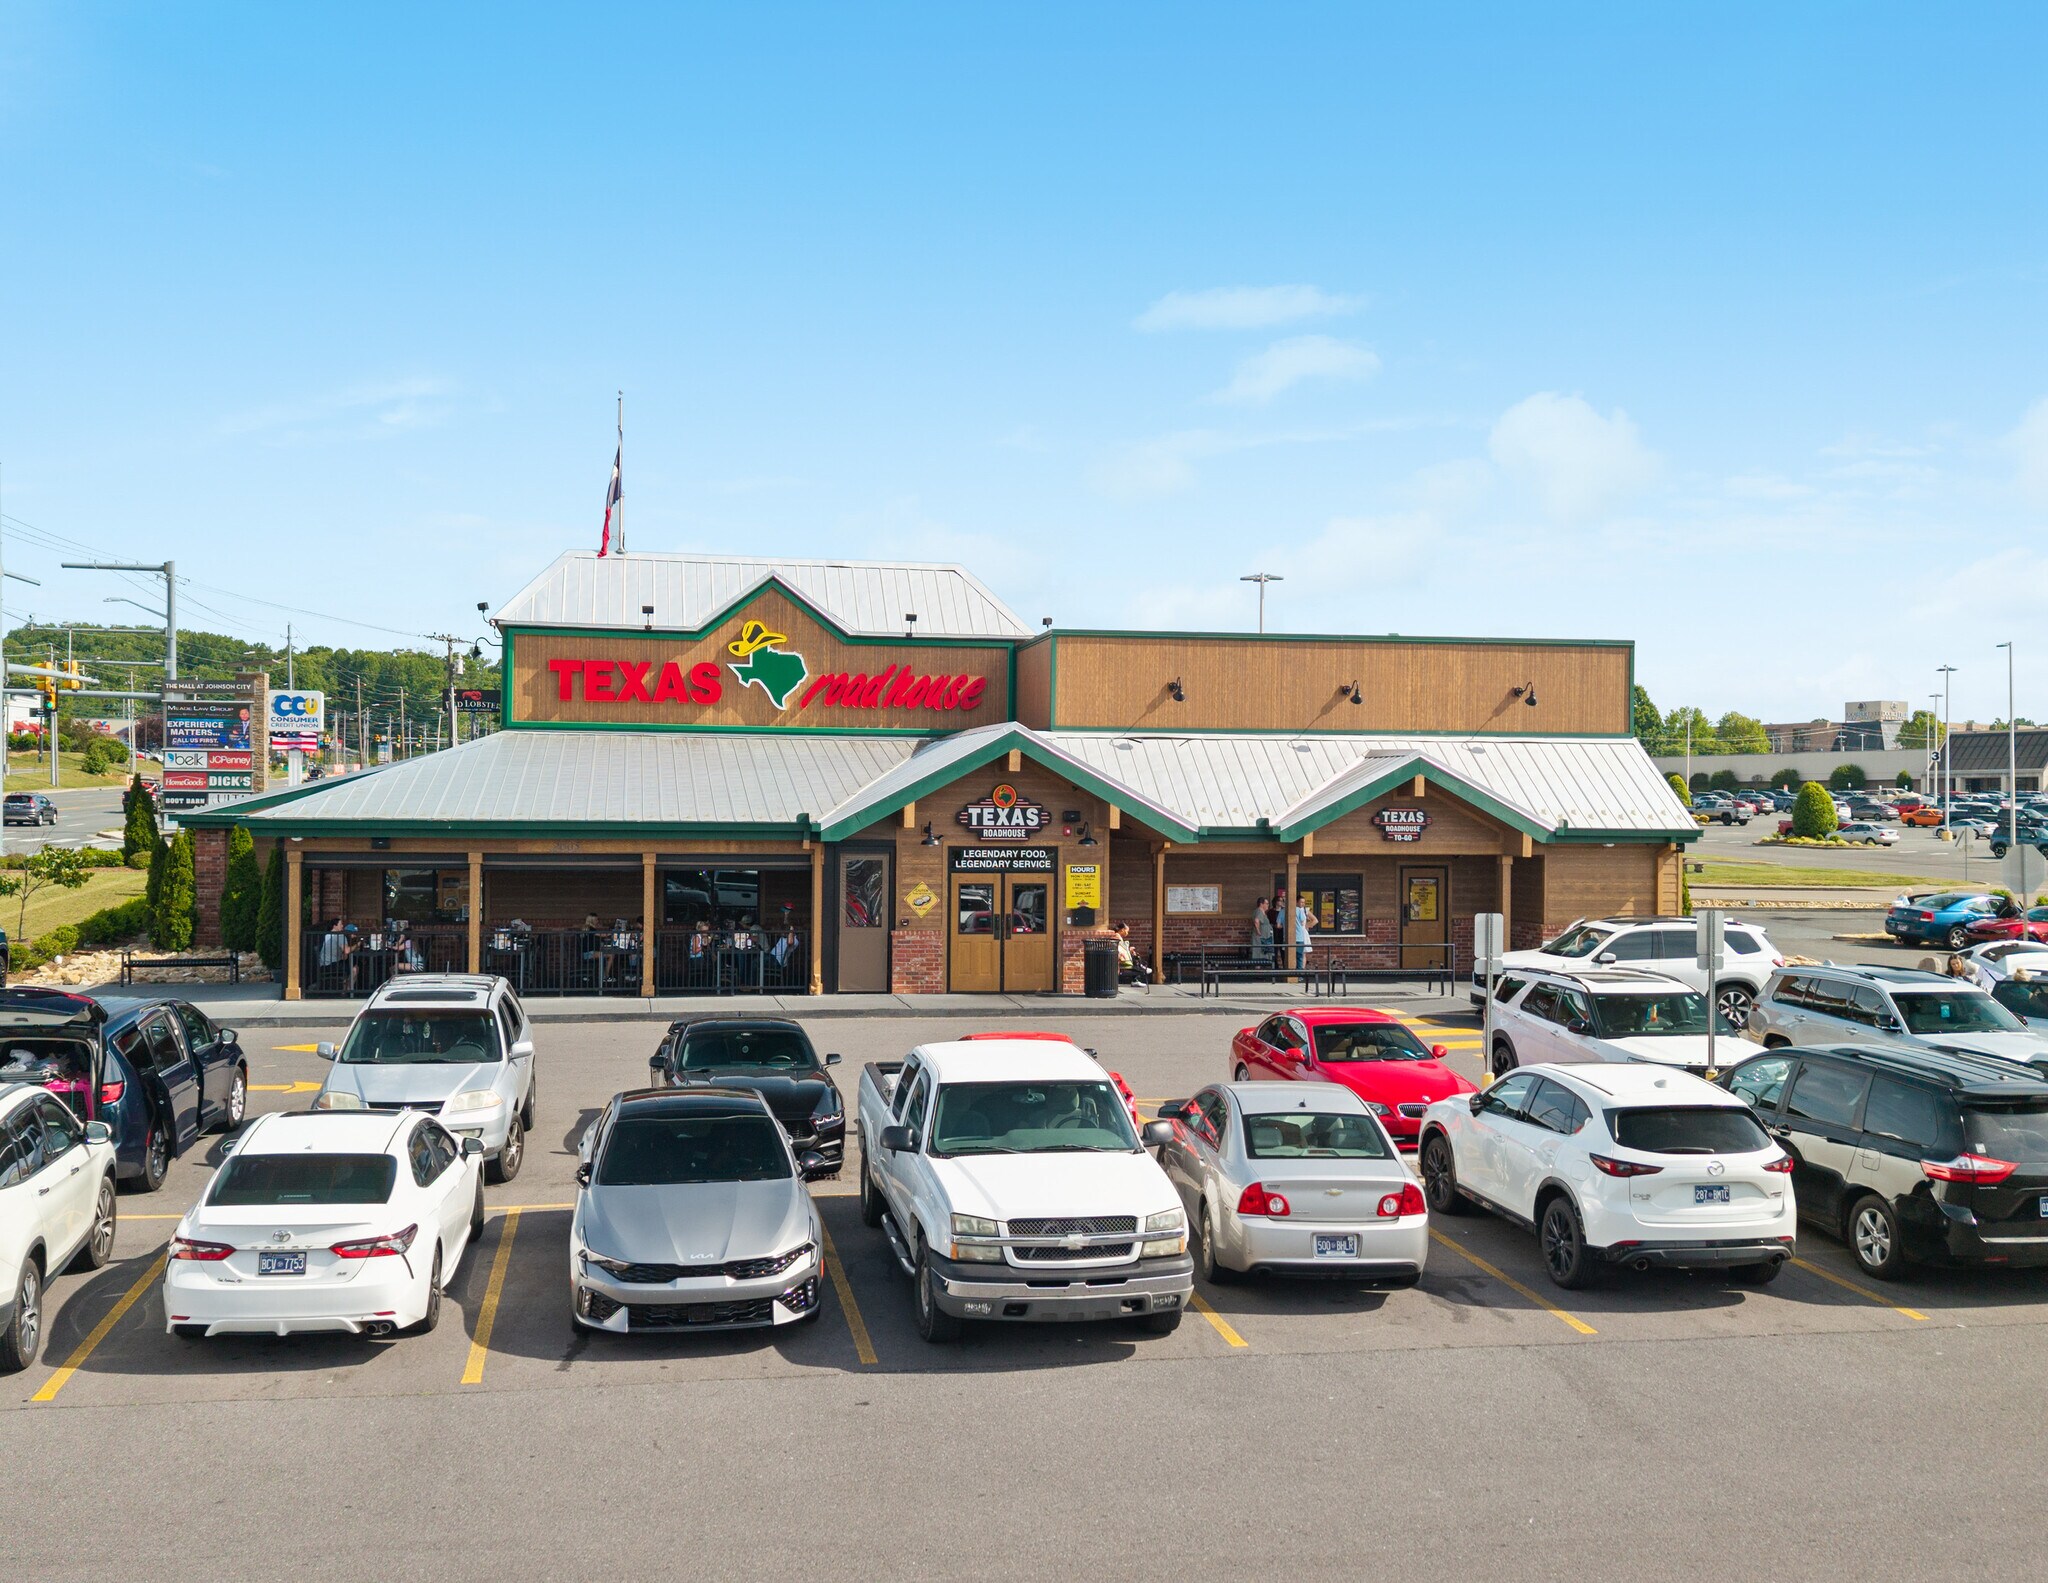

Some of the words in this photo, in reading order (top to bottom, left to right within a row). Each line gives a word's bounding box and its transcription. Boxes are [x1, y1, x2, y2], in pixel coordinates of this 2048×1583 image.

[548, 659, 722, 705] TEXAS
[800, 664, 987, 711] roadhouse
[273, 694, 318, 717] CCU
[167, 721, 224, 729] EXPERIENCE
[170, 729, 221, 737] MATTERS...
[175, 752, 203, 766] belk
[209, 755, 251, 765] JCPenney
[1931, 751, 1940, 761] 3
[165, 778, 205, 786] HomeGoods
[209, 775, 251, 787] DICK'S
[968, 807, 1039, 826] TEXAS
[1382, 811, 1425, 823] TEXAS
[983, 829, 1026, 838] ROADHOUSE
[963, 850, 1018, 858] LEGENDARY
[1020, 850, 1048, 859] FOOD,
[955, 860, 1010, 868] LEGENDARY
[1012, 860, 1051, 868] SERVICE
[1695, 1189, 1708, 1199] 287
[1317, 1240, 1331, 1251] 500
[1336, 1240, 1354, 1251] BHLR
[261, 1259, 277, 1270] BCV
[284, 1258, 304, 1270] 7753
